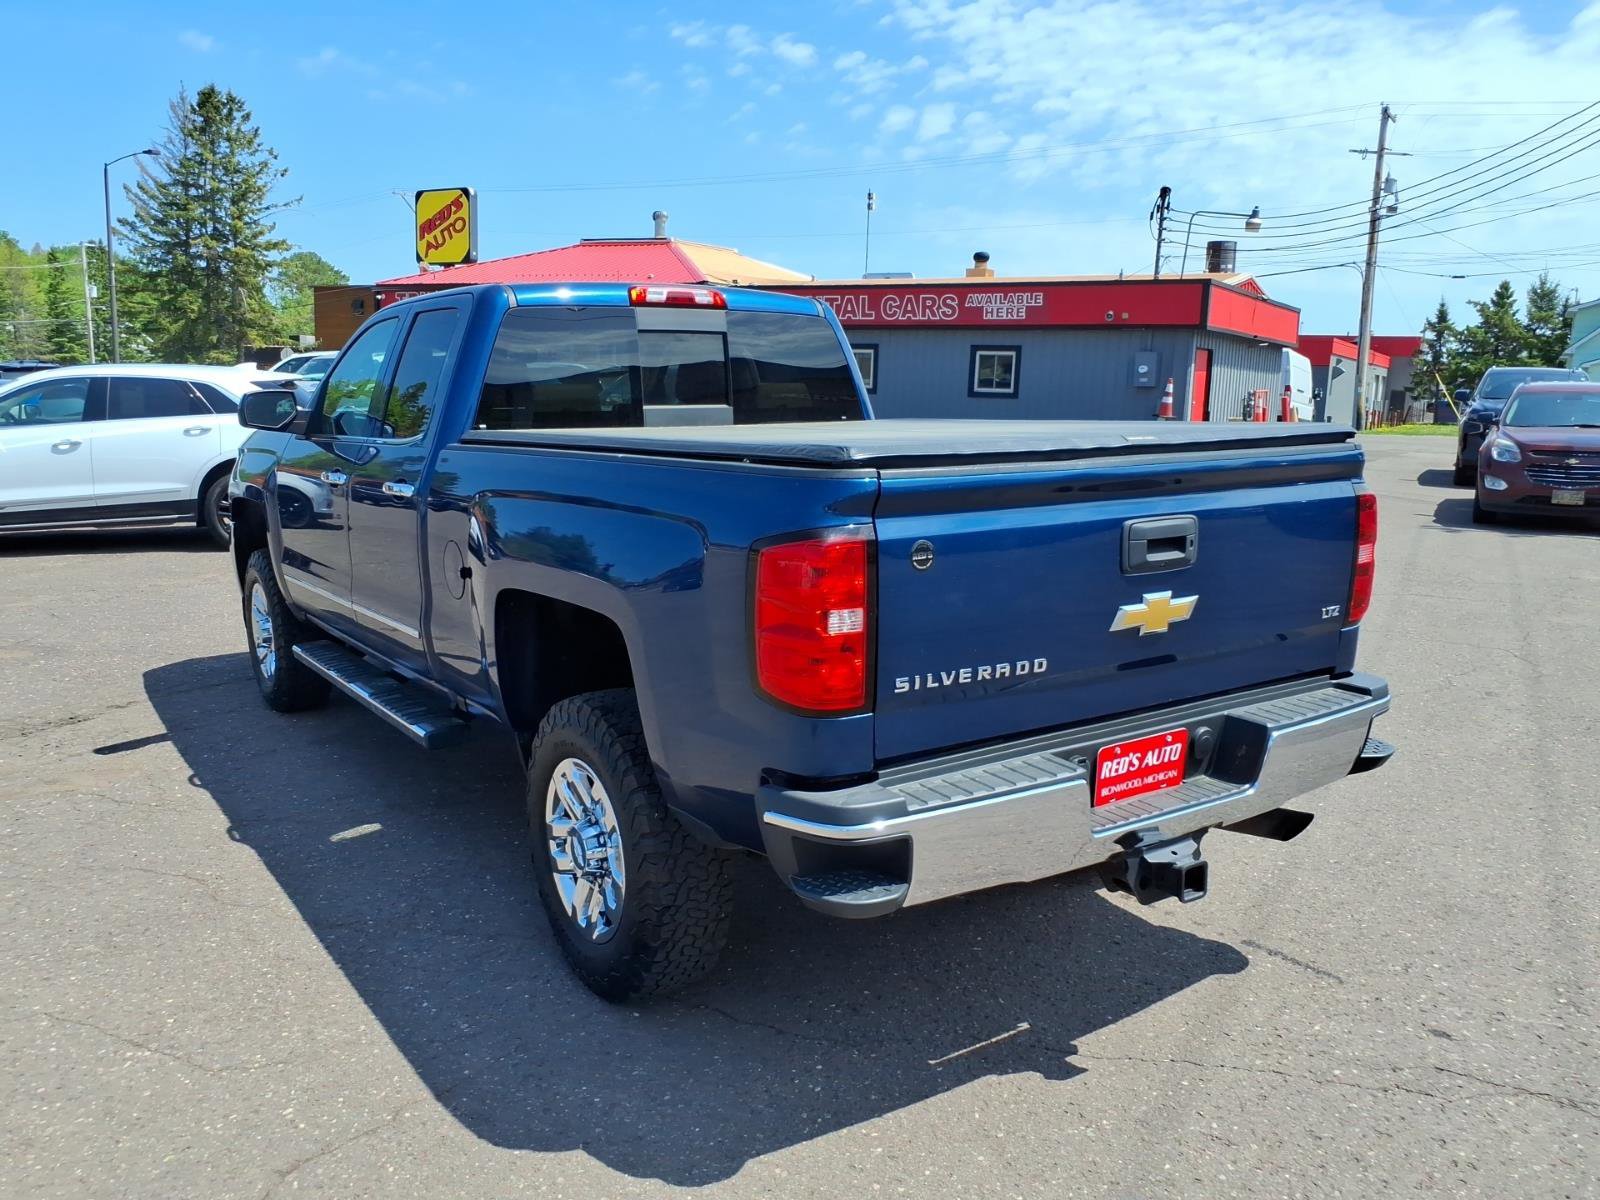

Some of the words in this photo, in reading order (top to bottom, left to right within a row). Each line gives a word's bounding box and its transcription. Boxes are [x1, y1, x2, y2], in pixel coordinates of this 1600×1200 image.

[424, 216, 467, 259] AUTO
[816, 296, 876, 320] TAL
[880, 294, 959, 320] CARS
[965, 292, 1043, 307] AVAILABLE
[983, 306, 1026, 320] HERE
[1322, 605, 1340, 618] LTZ
[894, 657, 1048, 694] SILVERADO
[1100, 751, 1142, 780] RED'S
[1141, 742, 1183, 768] AUTO
[1100, 777, 1143, 797] IRONWOOD,
[1142, 768, 1178, 785] MICHIGAN
